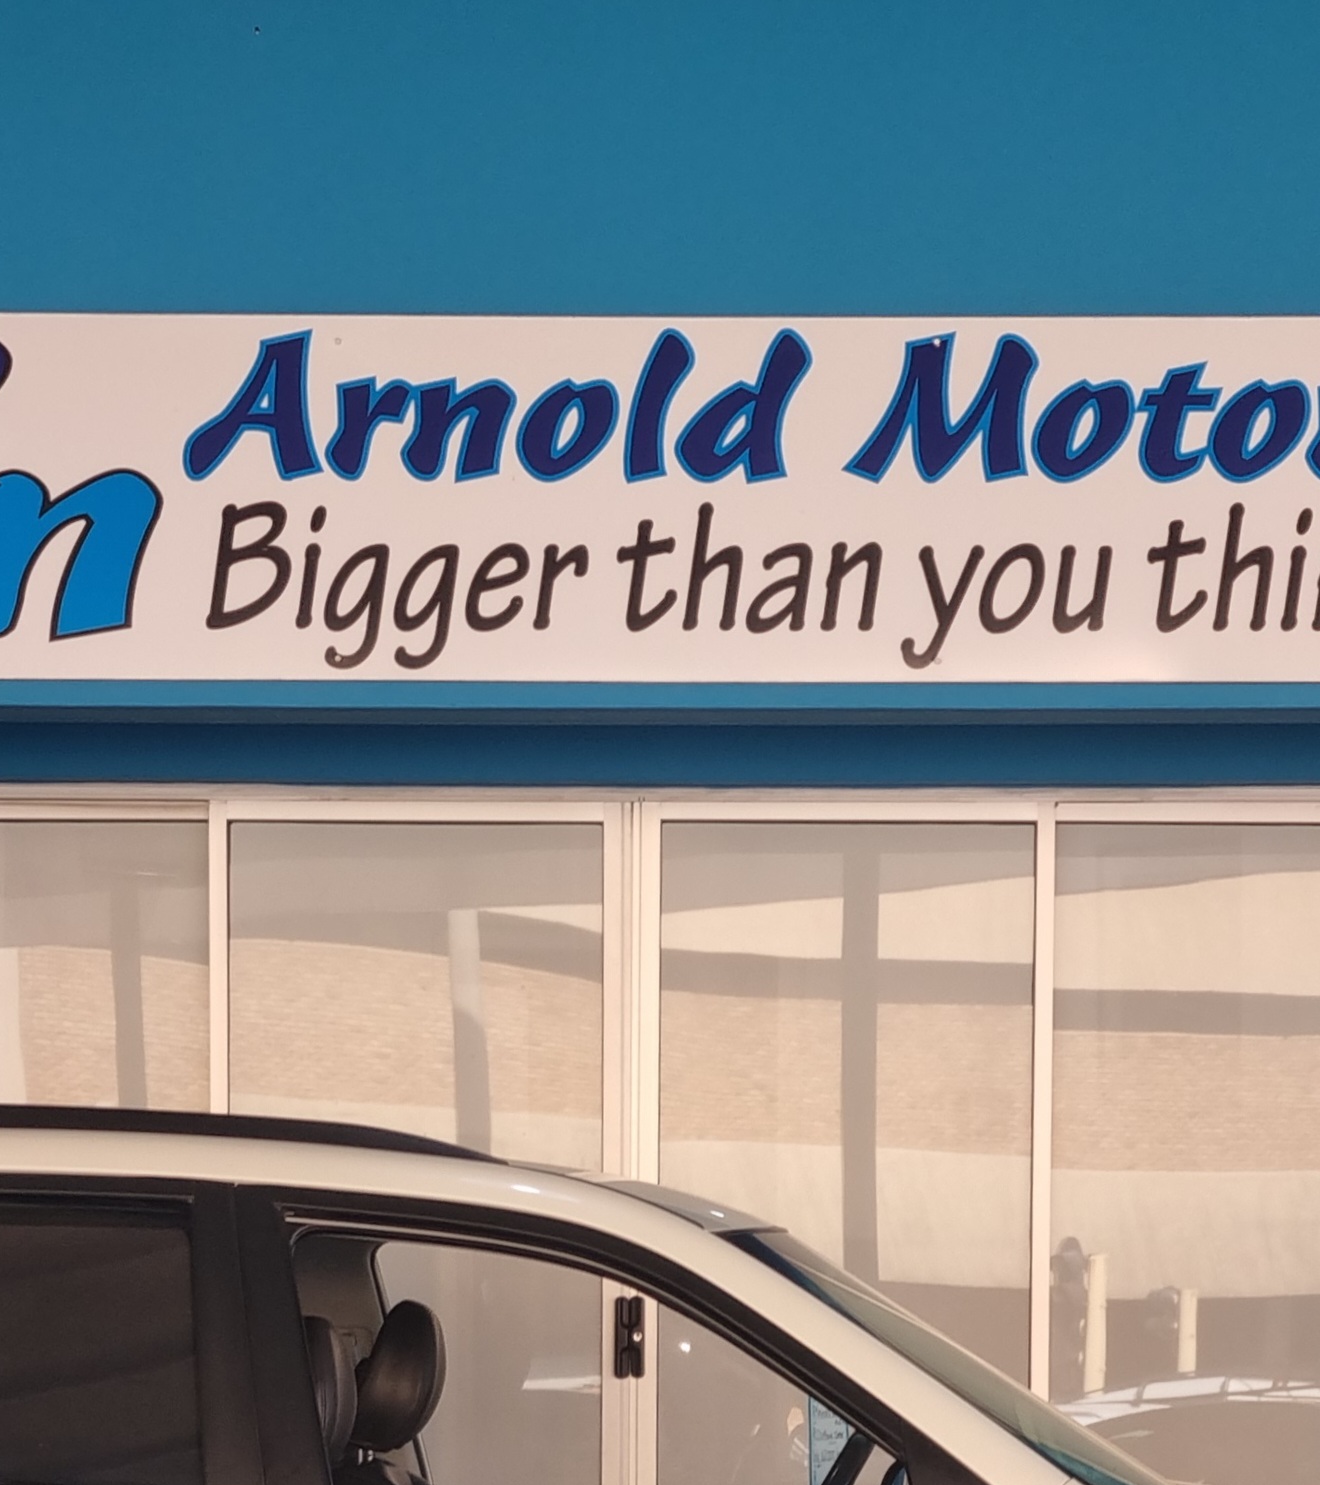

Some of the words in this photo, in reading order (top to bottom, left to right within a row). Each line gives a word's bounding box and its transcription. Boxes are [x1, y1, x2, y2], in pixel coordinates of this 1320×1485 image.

[182, 327, 813, 485] Arnold
[205, 502, 589, 671] Bigger
[615, 502, 882, 634] than
[900, 543, 1113, 670] you
